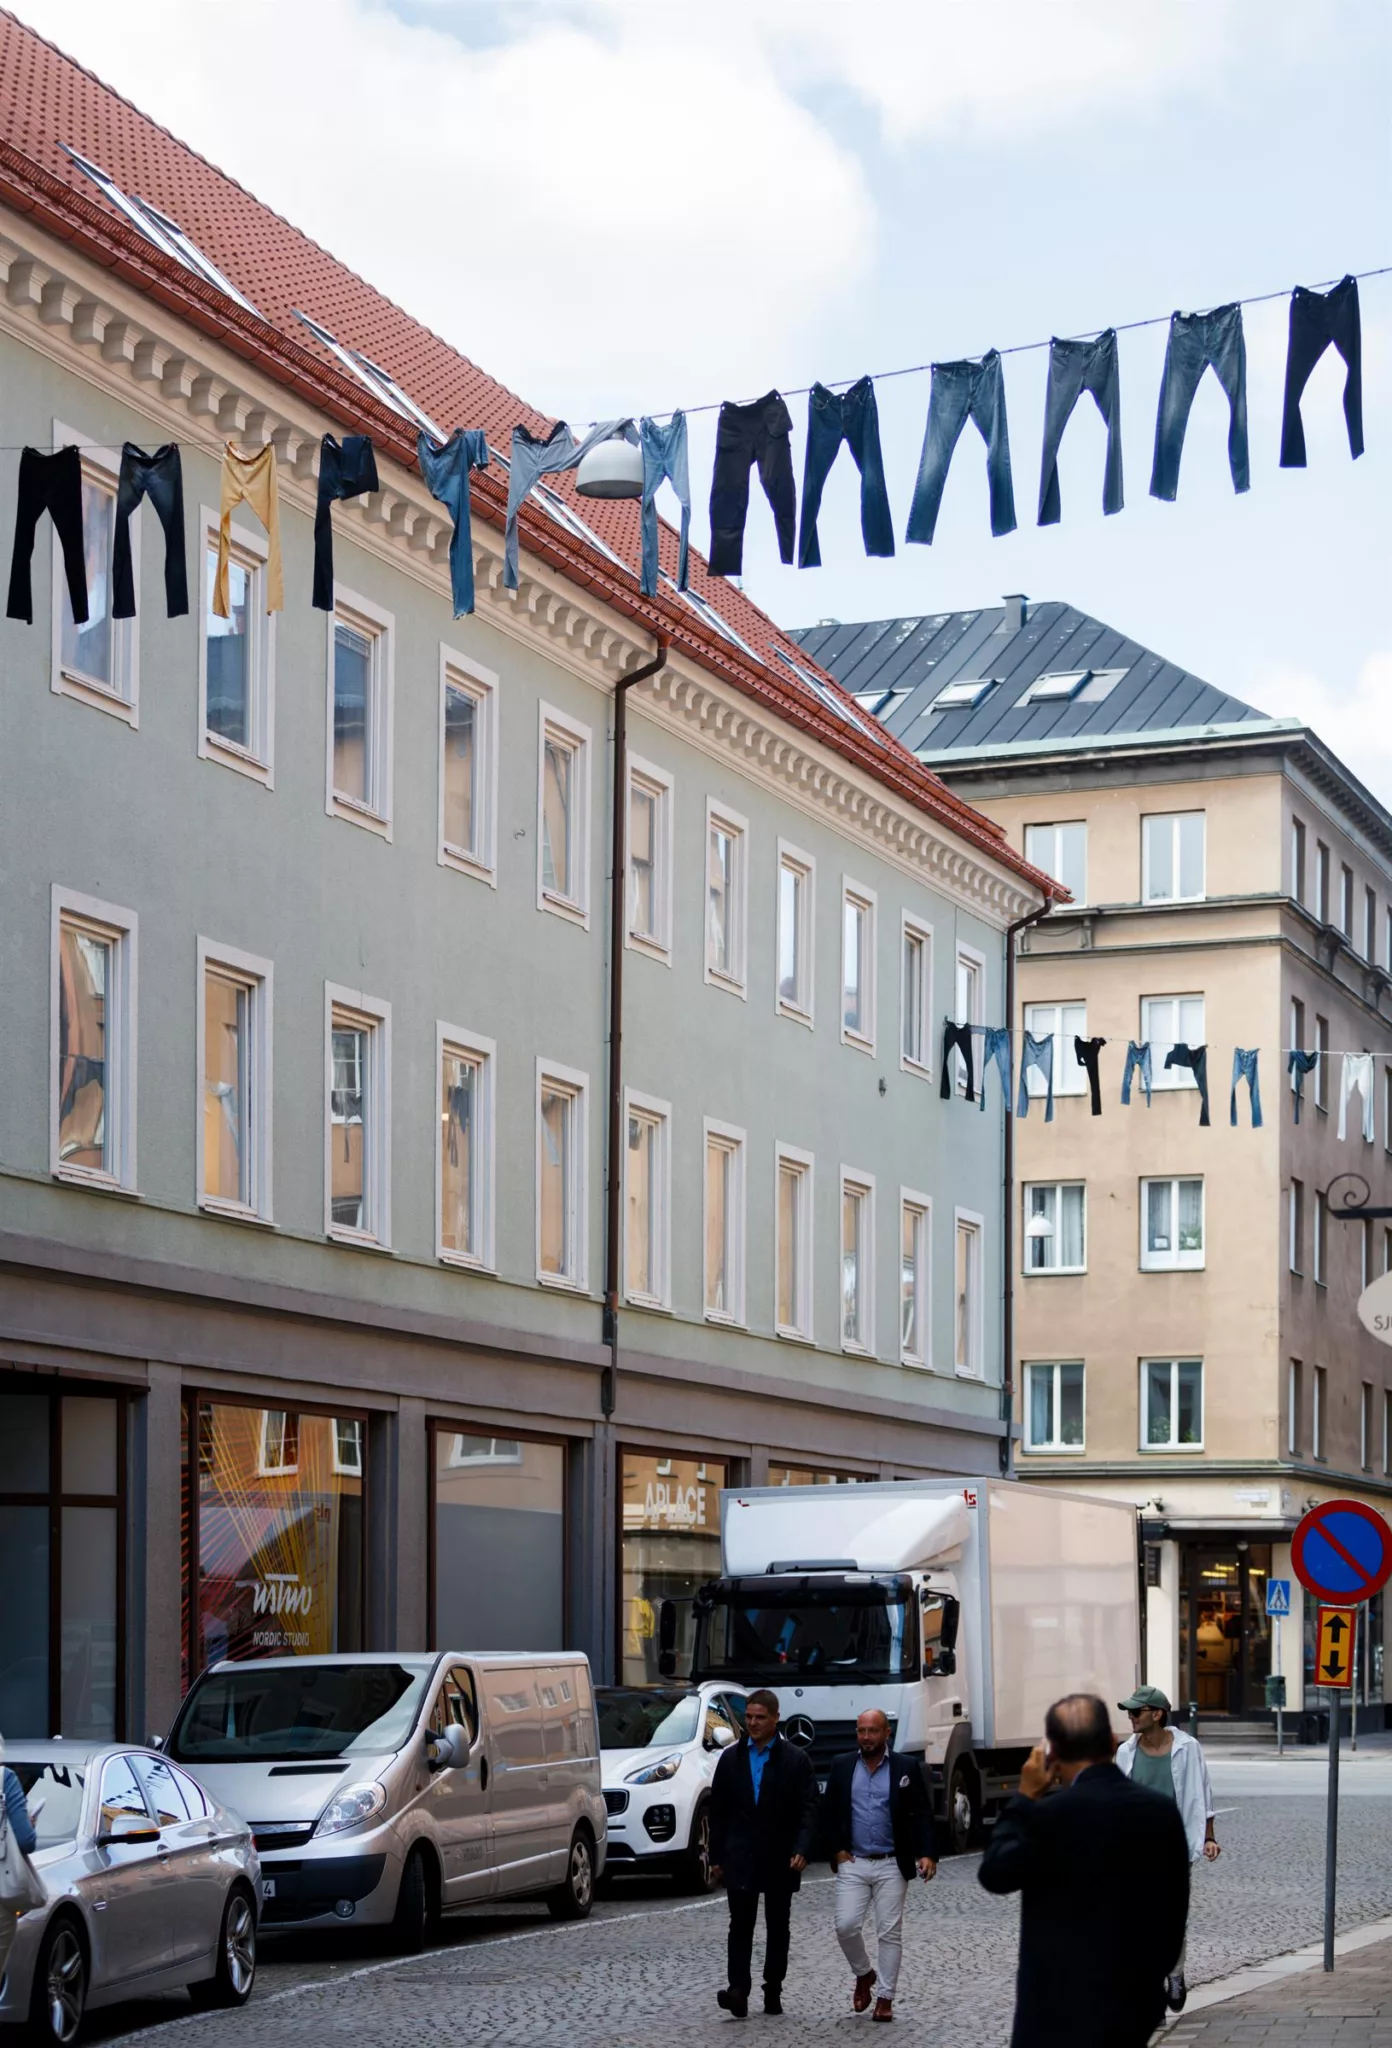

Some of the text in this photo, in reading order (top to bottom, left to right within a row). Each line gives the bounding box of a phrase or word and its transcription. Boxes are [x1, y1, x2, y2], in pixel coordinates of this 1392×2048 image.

[645, 1482, 706, 1525] APLACE
[253, 1632, 310, 1647] NORDIC STUDIO
